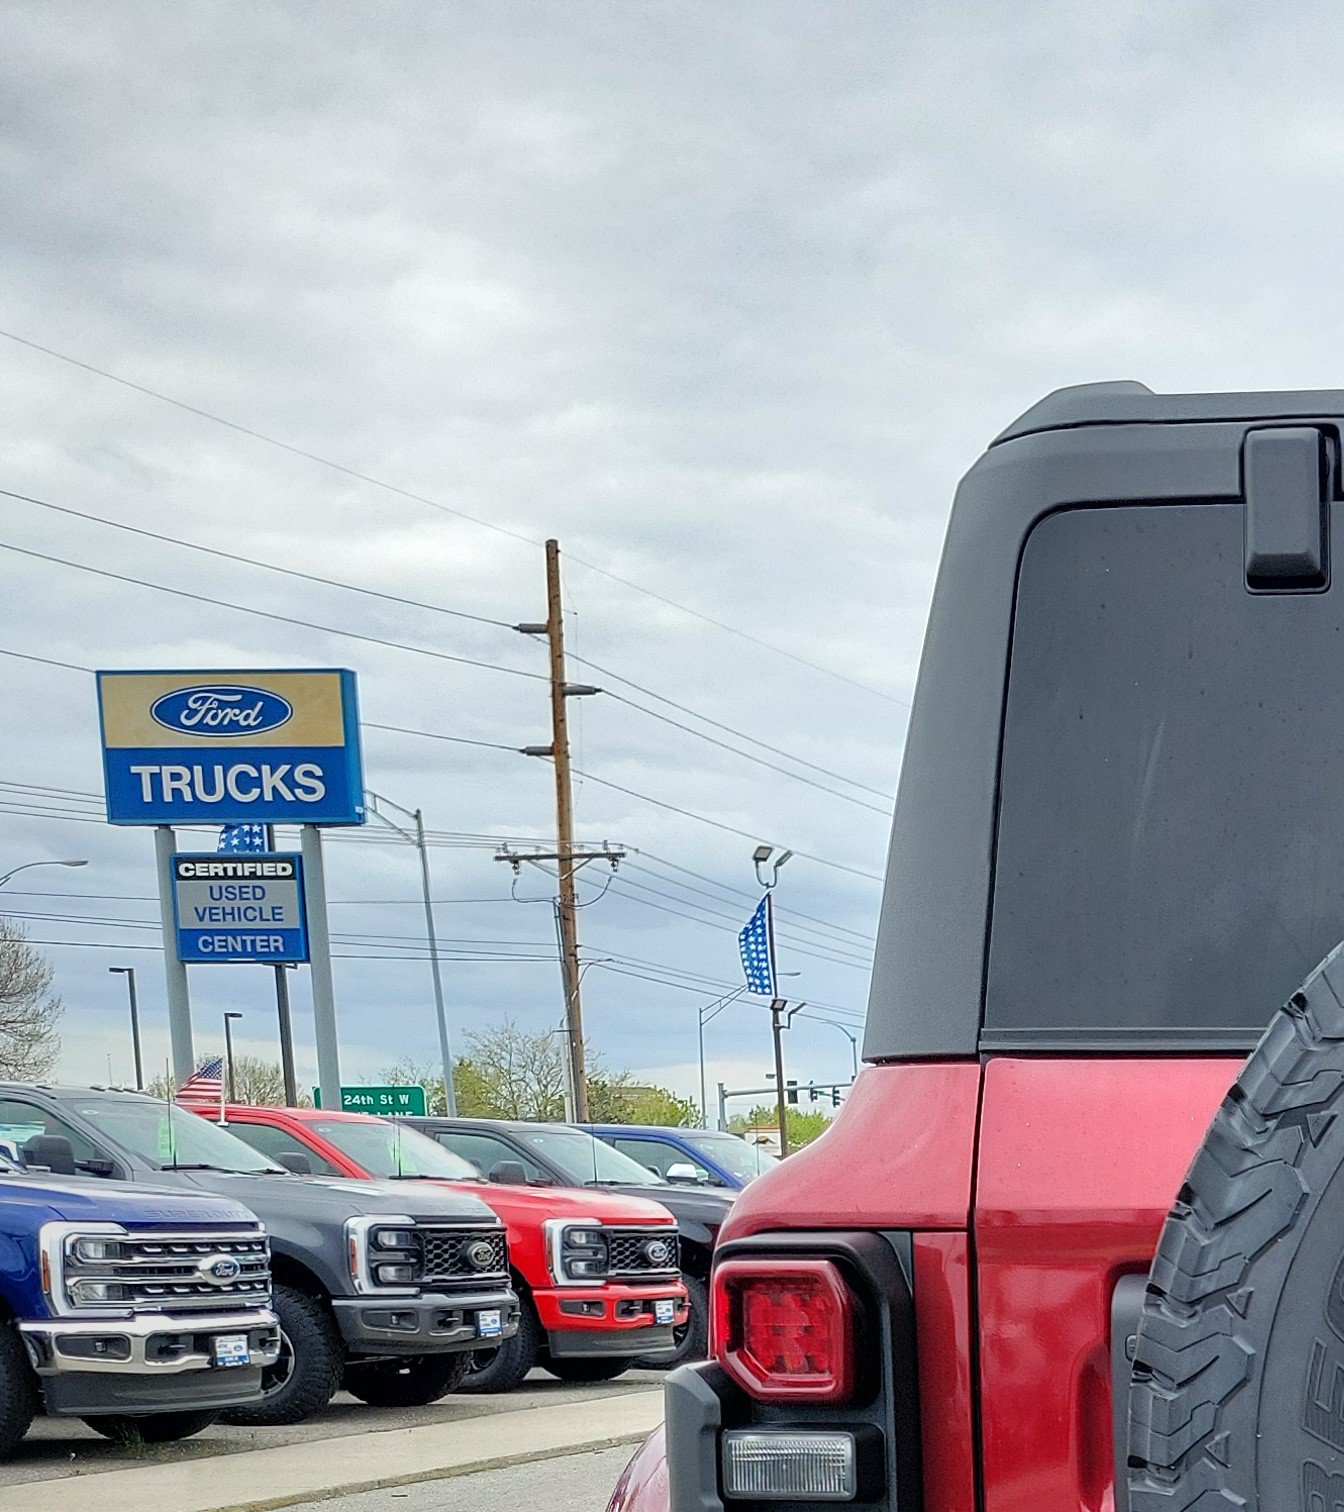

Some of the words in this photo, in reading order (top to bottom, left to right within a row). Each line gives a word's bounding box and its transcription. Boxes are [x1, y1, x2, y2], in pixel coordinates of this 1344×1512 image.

[180, 692, 264, 727] Ford
[129, 763, 326, 803] TRUCKS
[178, 862, 293, 877] CERTIFIED
[208, 885, 266, 901] USED
[193, 905, 284, 922] VEHICLE
[197, 935, 284, 953] CENTER
[343, 1094, 374, 1106] 24th
[379, 1094, 394, 1106] St
[398, 1094, 410, 1105] W
